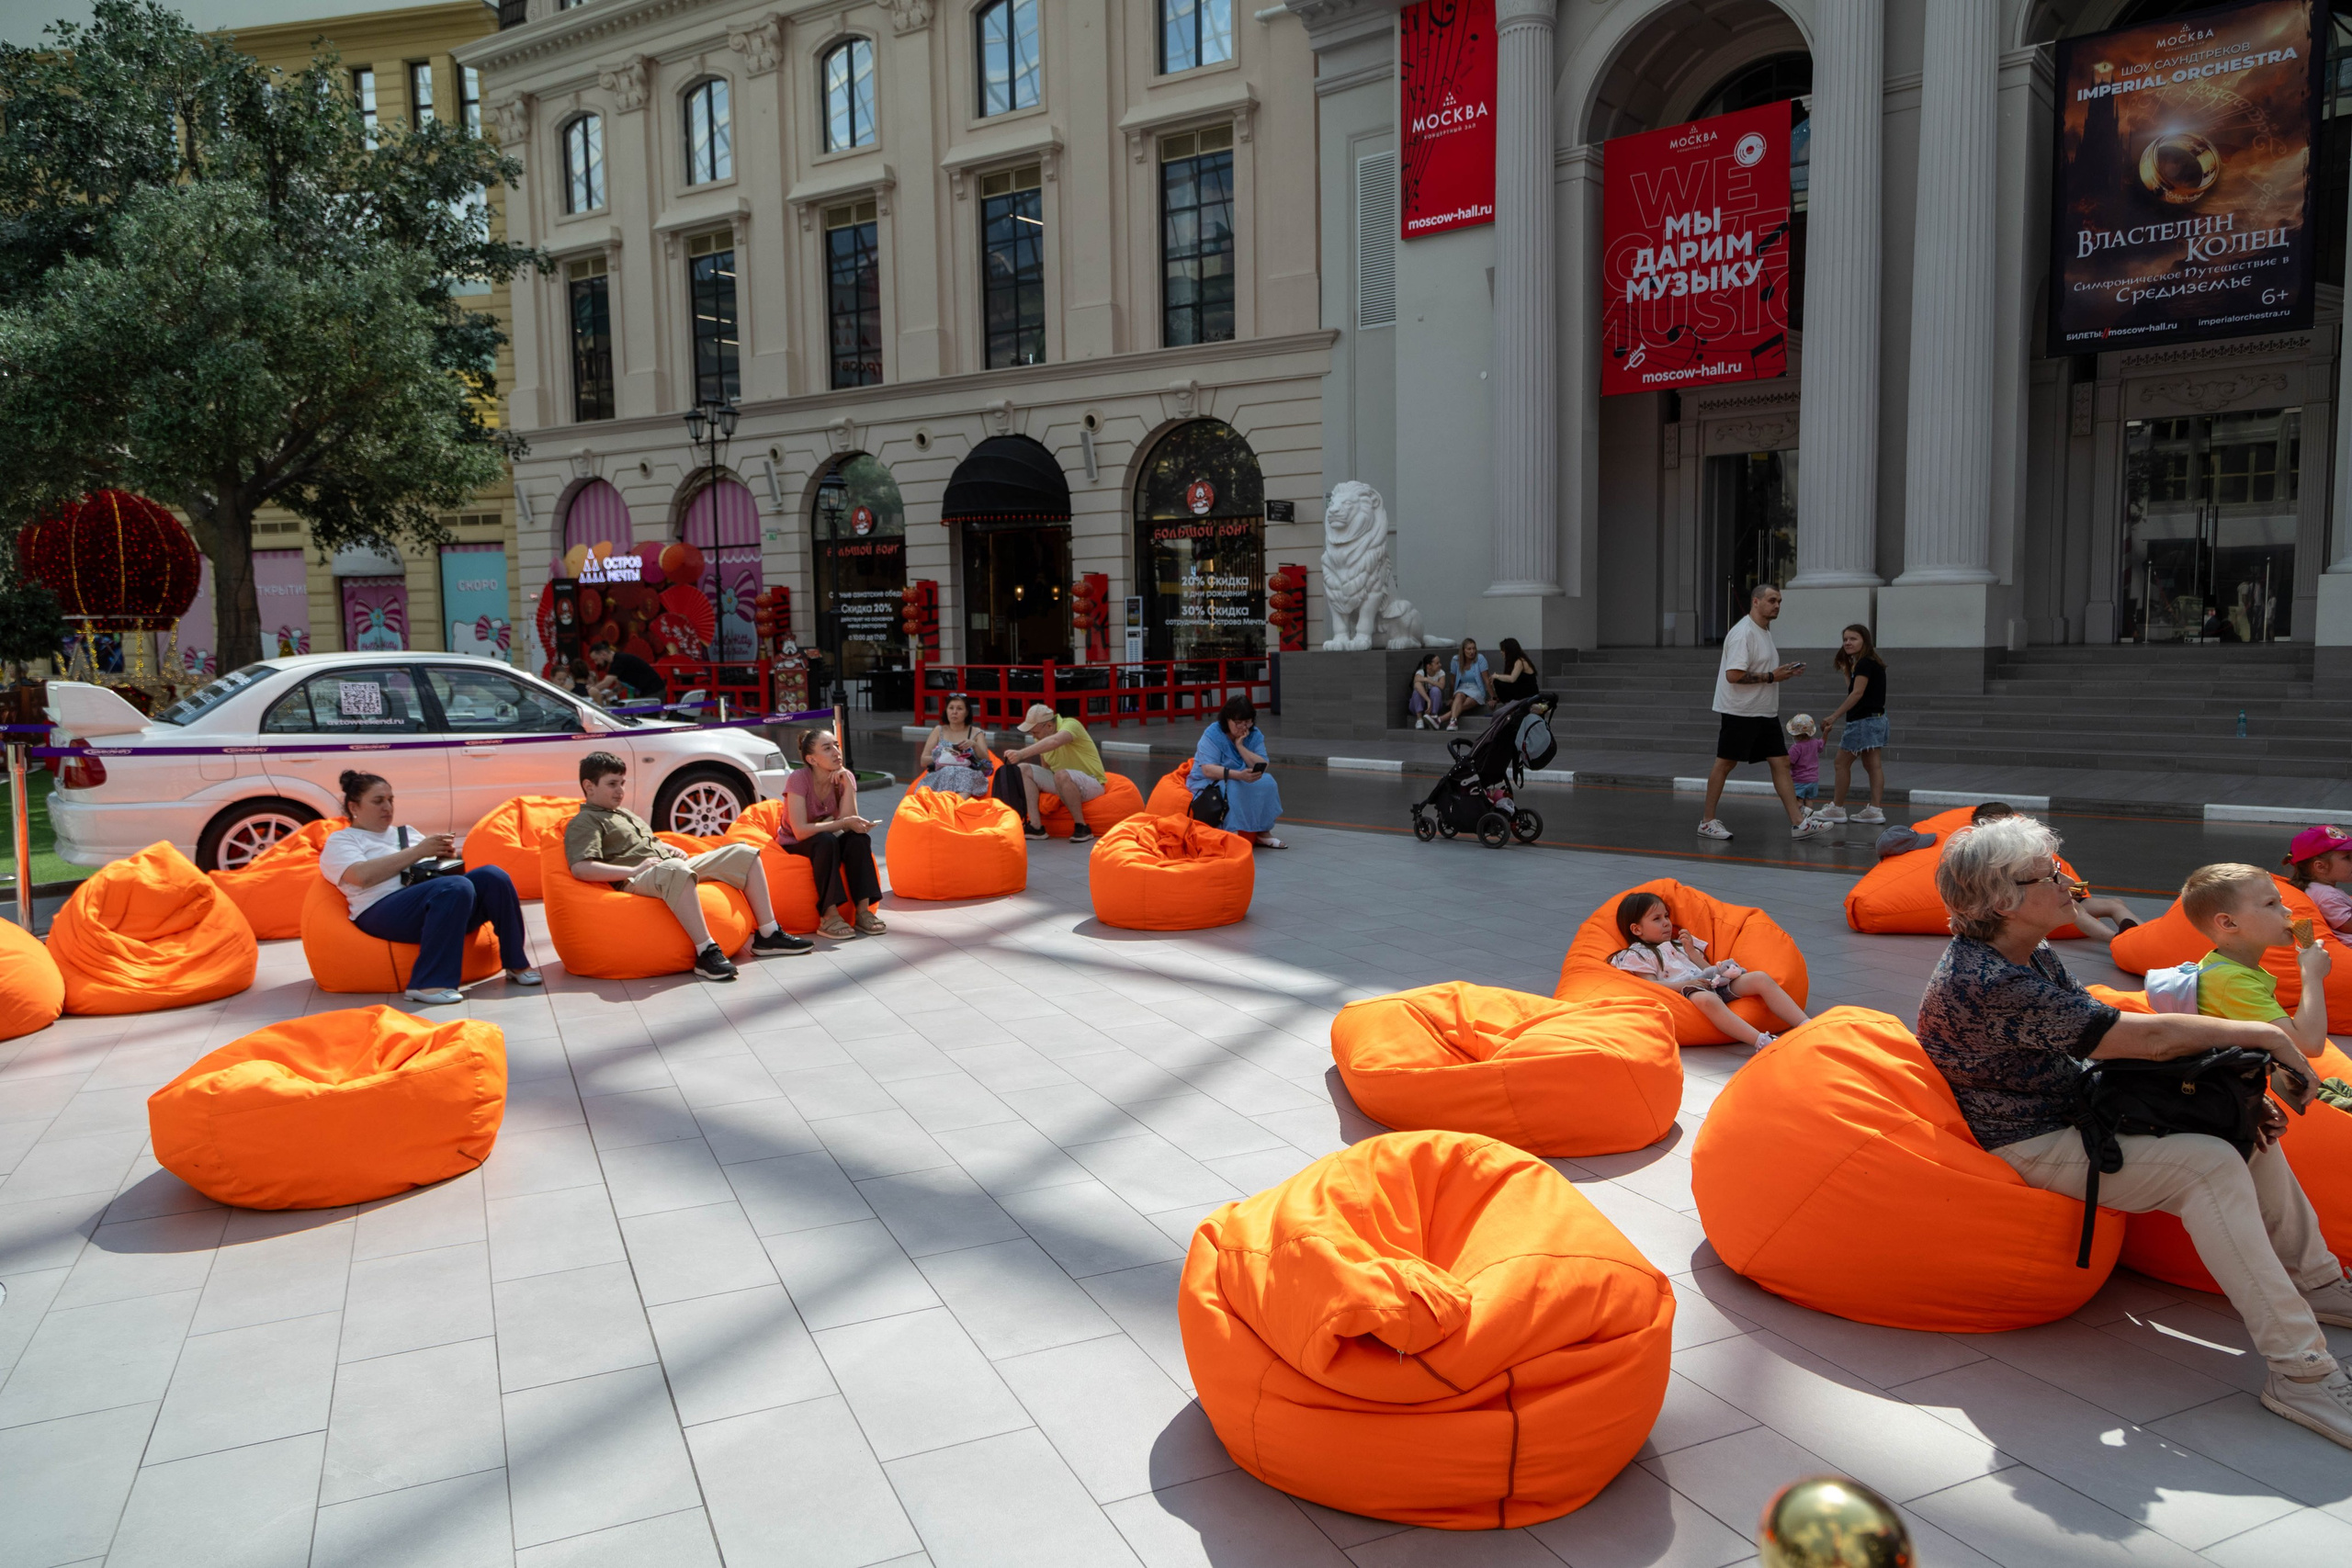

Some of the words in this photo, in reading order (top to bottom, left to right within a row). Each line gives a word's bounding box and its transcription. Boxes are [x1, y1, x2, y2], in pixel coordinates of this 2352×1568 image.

[2155, 28, 2214, 49] МОСКВА
[2120, 61, 2152, 77] ШОУ
[2154, 41, 2251, 70] САУНДТРЕКОВ
[2076, 73, 2166, 102] IMPERIAL
[2171, 46, 2299, 84] ORCHESTRA
[1411, 100, 1488, 133] МОСКВА
[1464, 122, 1476, 130] ЗАЛ
[1669, 130, 1718, 150] МОСКВА
[1408, 204, 1492, 231] moscow-hall.ru
[1665, 206, 1722, 241] МЫ
[1633, 231, 1753, 278] ДАРИМ
[1625, 258, 1765, 304] МУЗЫКУ
[2074, 271, 2181, 293] Симфоническое
[2184, 258, 2278, 279] Путешествие
[2115, 275, 2252, 306] Средиземье
[2260, 287, 2290, 305] 6+
[2198, 309, 2290, 327] imperialorchestra.ru
[1642, 361, 1743, 384] moscow-hall.ru
[1154, 522, 1214, 539] БОЛЬШОЙ
[1218, 524, 1250, 536] ВОНГ
[827, 541, 873, 557] БЛЬШОЙ
[876, 544, 899, 555] ВОНГ
[603, 555, 642, 570] ОСТРОВ
[605, 569, 641, 581] МЕЧТЫ
[1182, 576, 1205, 586] 20%
[1206, 576, 1250, 587] Скидка
[457, 579, 498, 592] СКОРО
[1205, 590, 1248, 598] рождения
[841, 603, 873, 615] Скидка
[873, 603, 893, 613] 20%
[1182, 605, 1205, 615] 30%
[1206, 605, 1250, 616] Скидка
[326, 716, 405, 726] avtoweekend.ru
